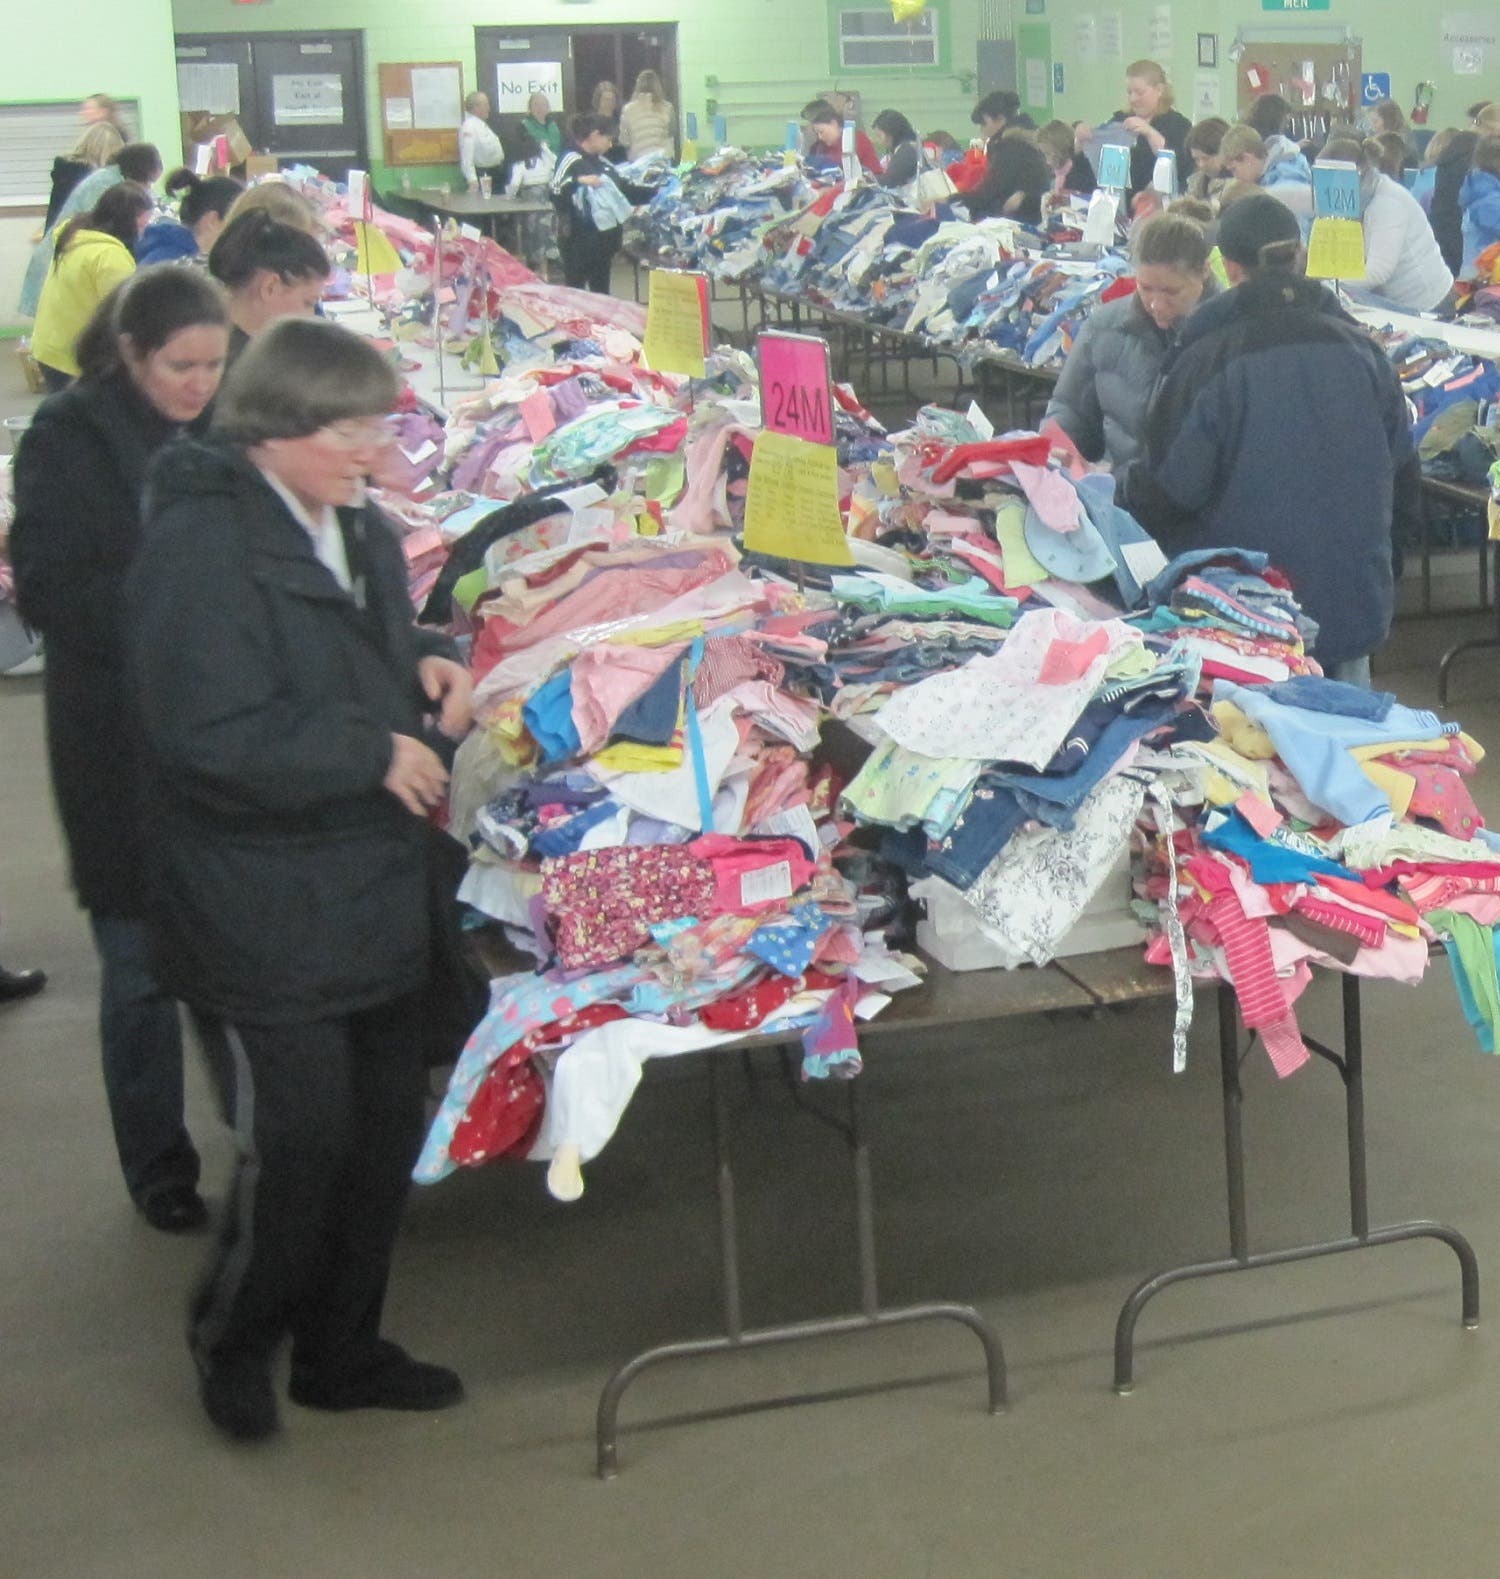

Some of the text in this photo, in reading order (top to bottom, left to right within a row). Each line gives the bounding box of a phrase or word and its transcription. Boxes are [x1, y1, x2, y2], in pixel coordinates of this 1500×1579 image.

[502, 81, 558, 94] No Exit
[1324, 186, 1356, 212] 12M
[771, 381, 826, 434] 24M
